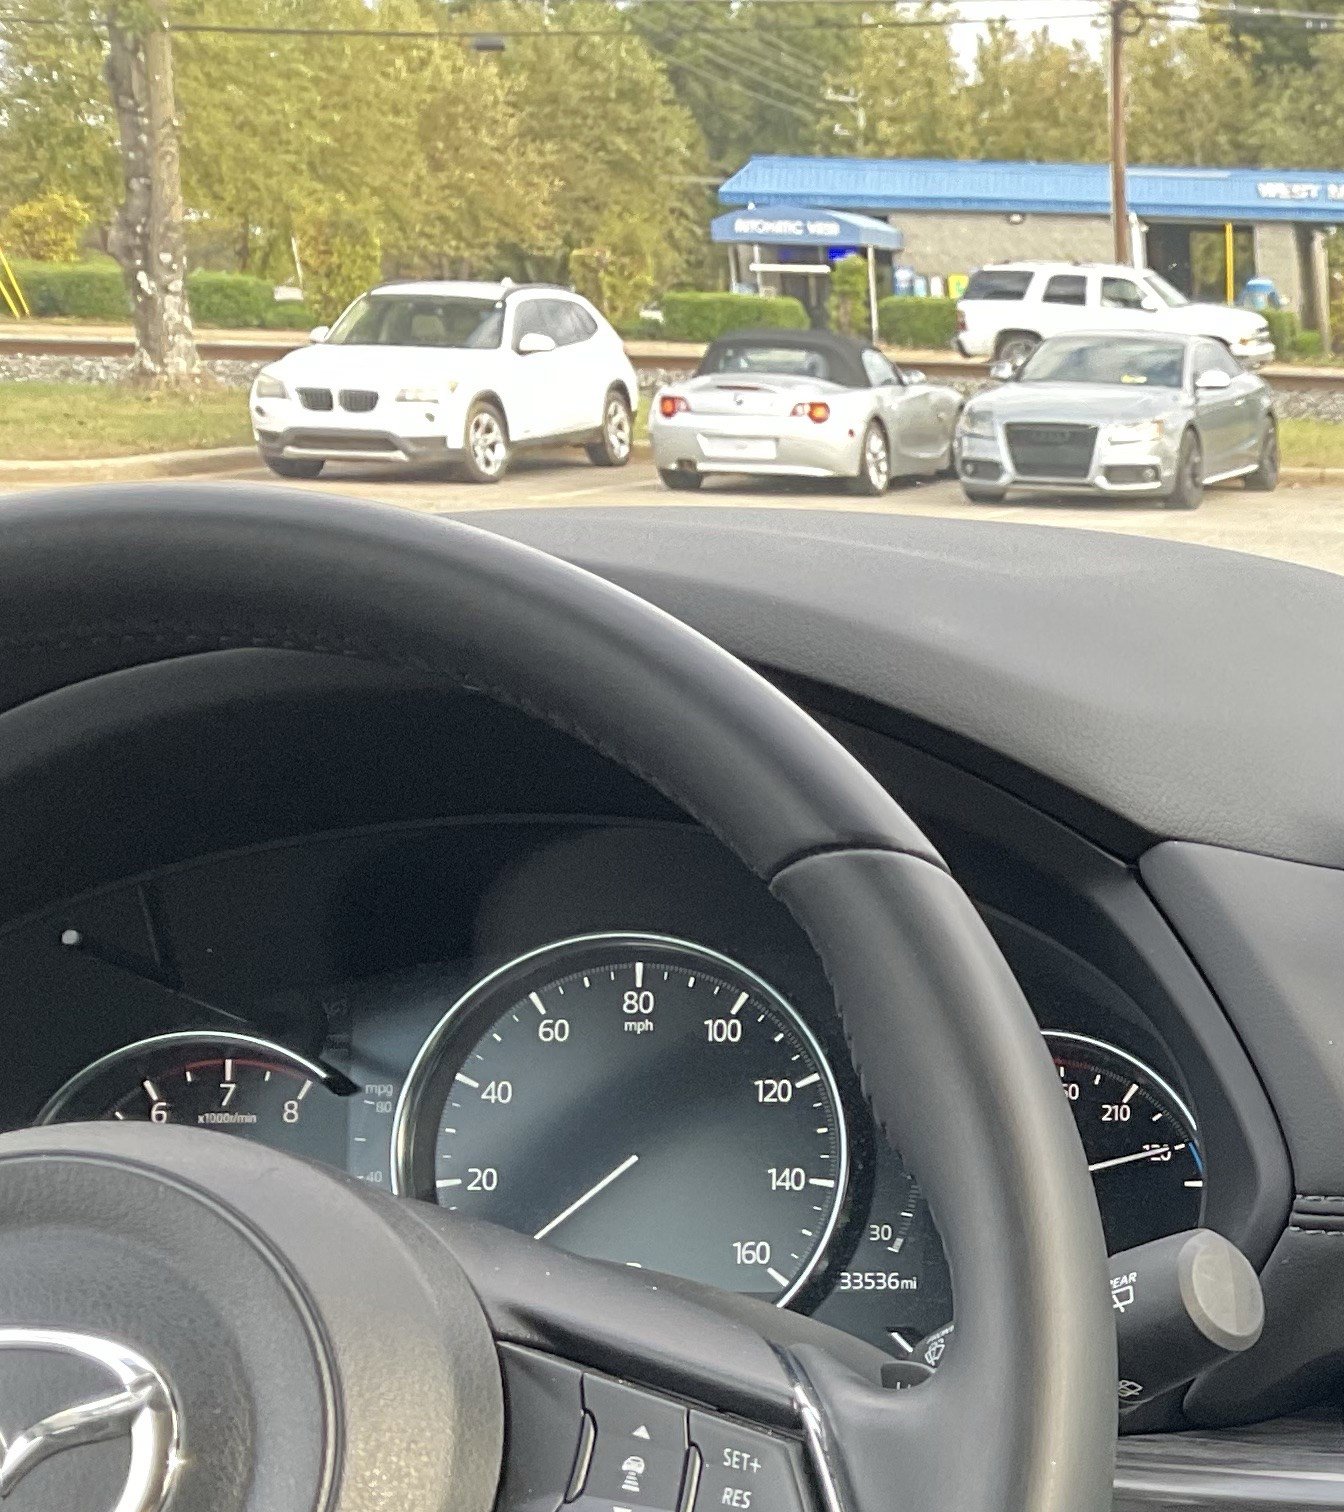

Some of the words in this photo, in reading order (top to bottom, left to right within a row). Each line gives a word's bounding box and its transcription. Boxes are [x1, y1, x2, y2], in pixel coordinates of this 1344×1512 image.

[622, 991, 655, 1014] 80
[538, 1019, 570, 1042] 60
[624, 1018, 654, 1035] mph
[703, 1018, 742, 1043] 100
[219, 1083, 236, 1106] 7
[480, 1080, 513, 1104] 40
[753, 1079, 792, 1103] 120
[149, 1100, 168, 1124] 6
[282, 1099, 300, 1123] 8
[1101, 1104, 1131, 1122] 210
[466, 1167, 498, 1191] 20
[767, 1167, 806, 1191] 140
[869, 1224, 892, 1241] 30
[732, 1241, 771, 1265] 160
[1109, 1271, 1138, 1289] EAR
[723, 1448, 762, 1473] SET+
[721, 1487, 752, 1509] RES
